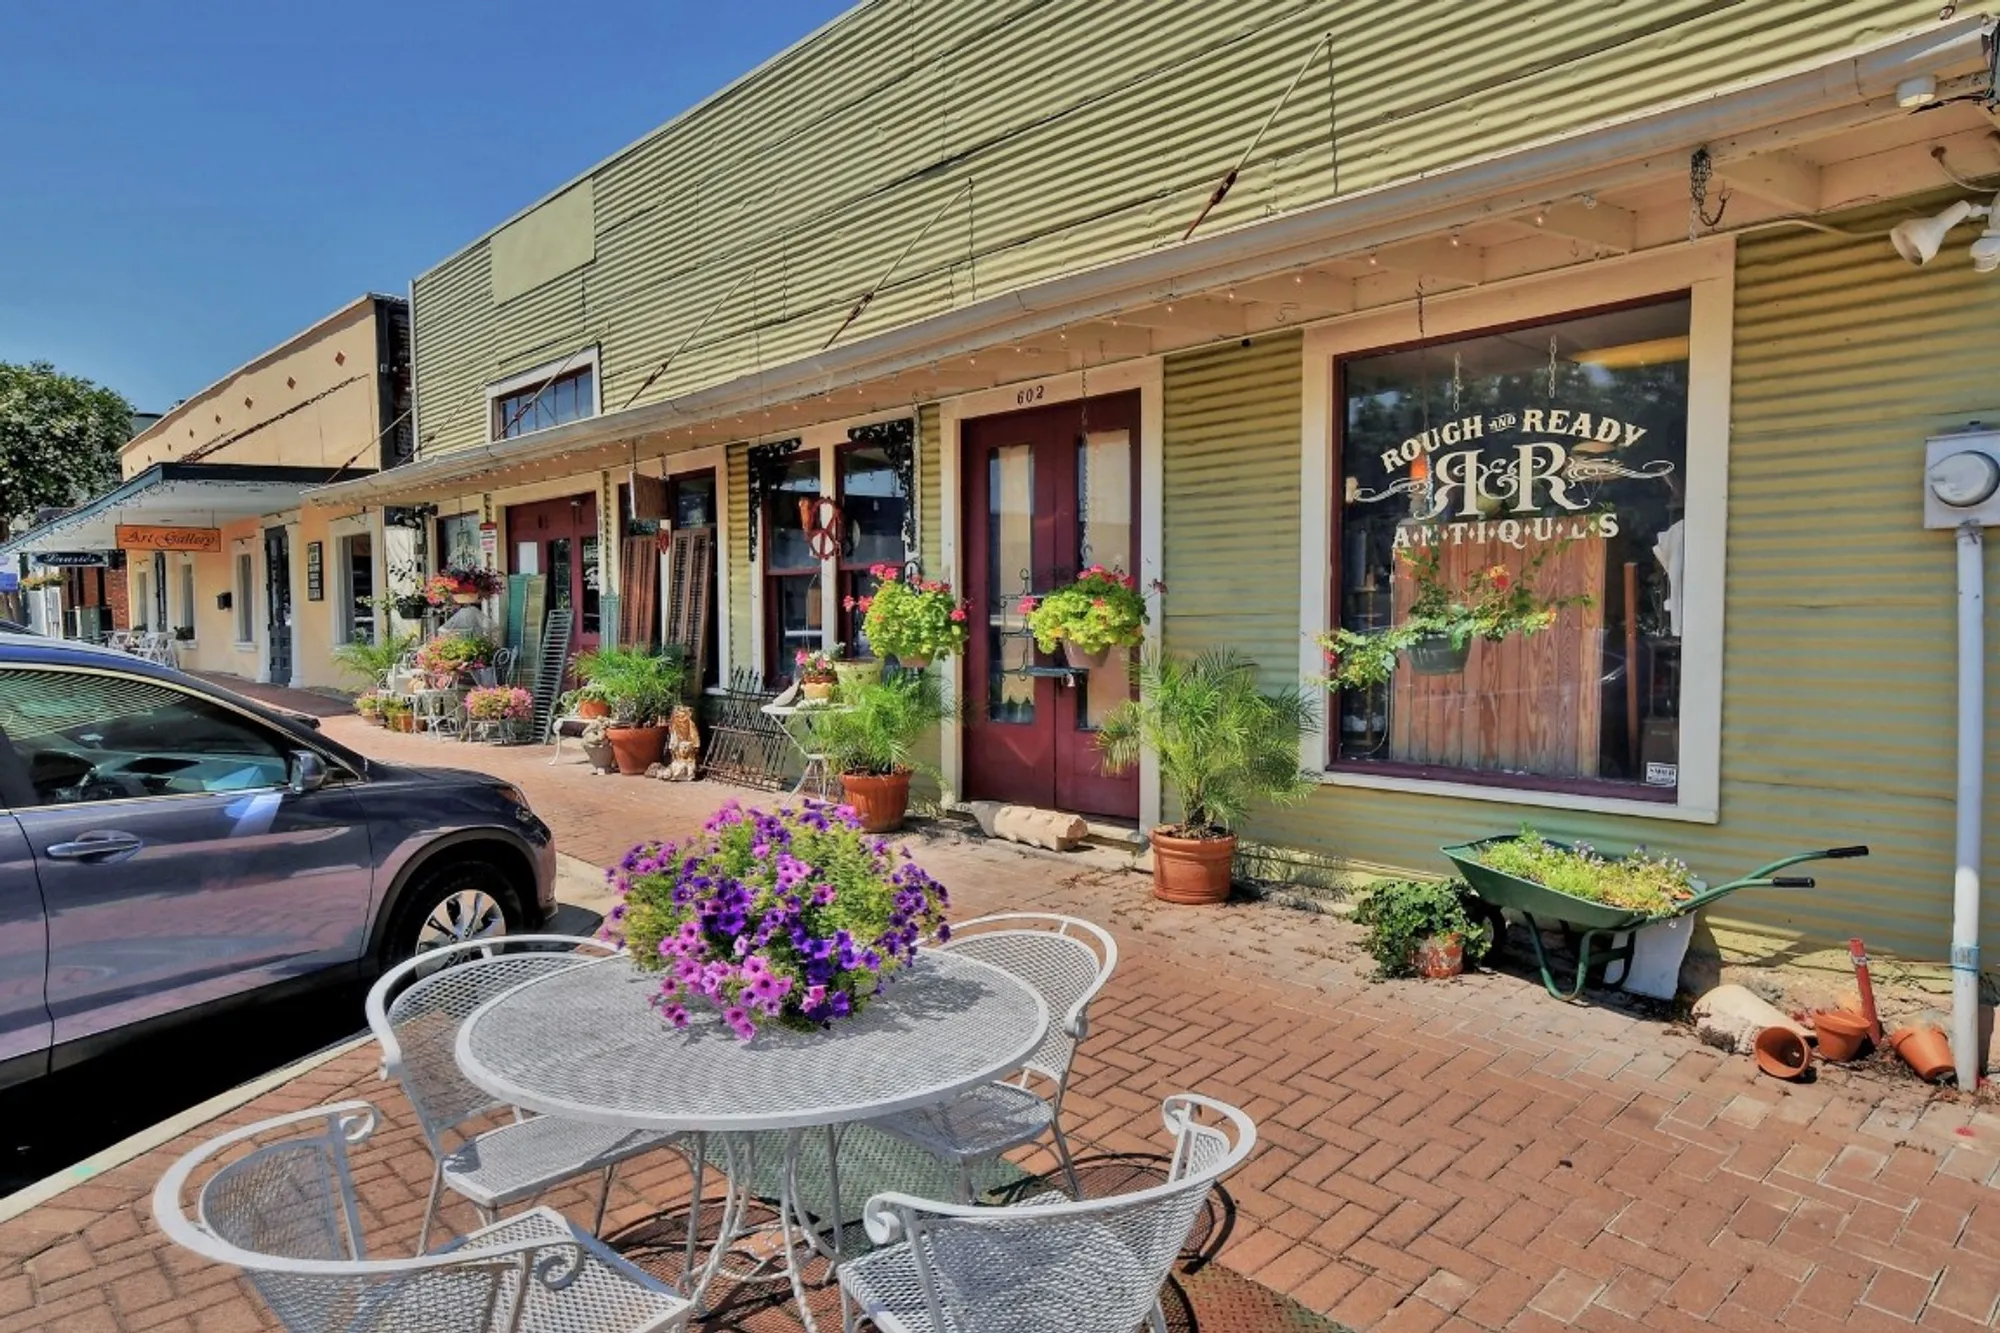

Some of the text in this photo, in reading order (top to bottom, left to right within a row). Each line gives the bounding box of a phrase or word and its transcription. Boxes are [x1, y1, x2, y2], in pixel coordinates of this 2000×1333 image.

[1016, 384, 1045, 405] 602
[1380, 409, 1648, 474] ROUGH AND READY
[123, 530, 215, 548] Art Gallery
